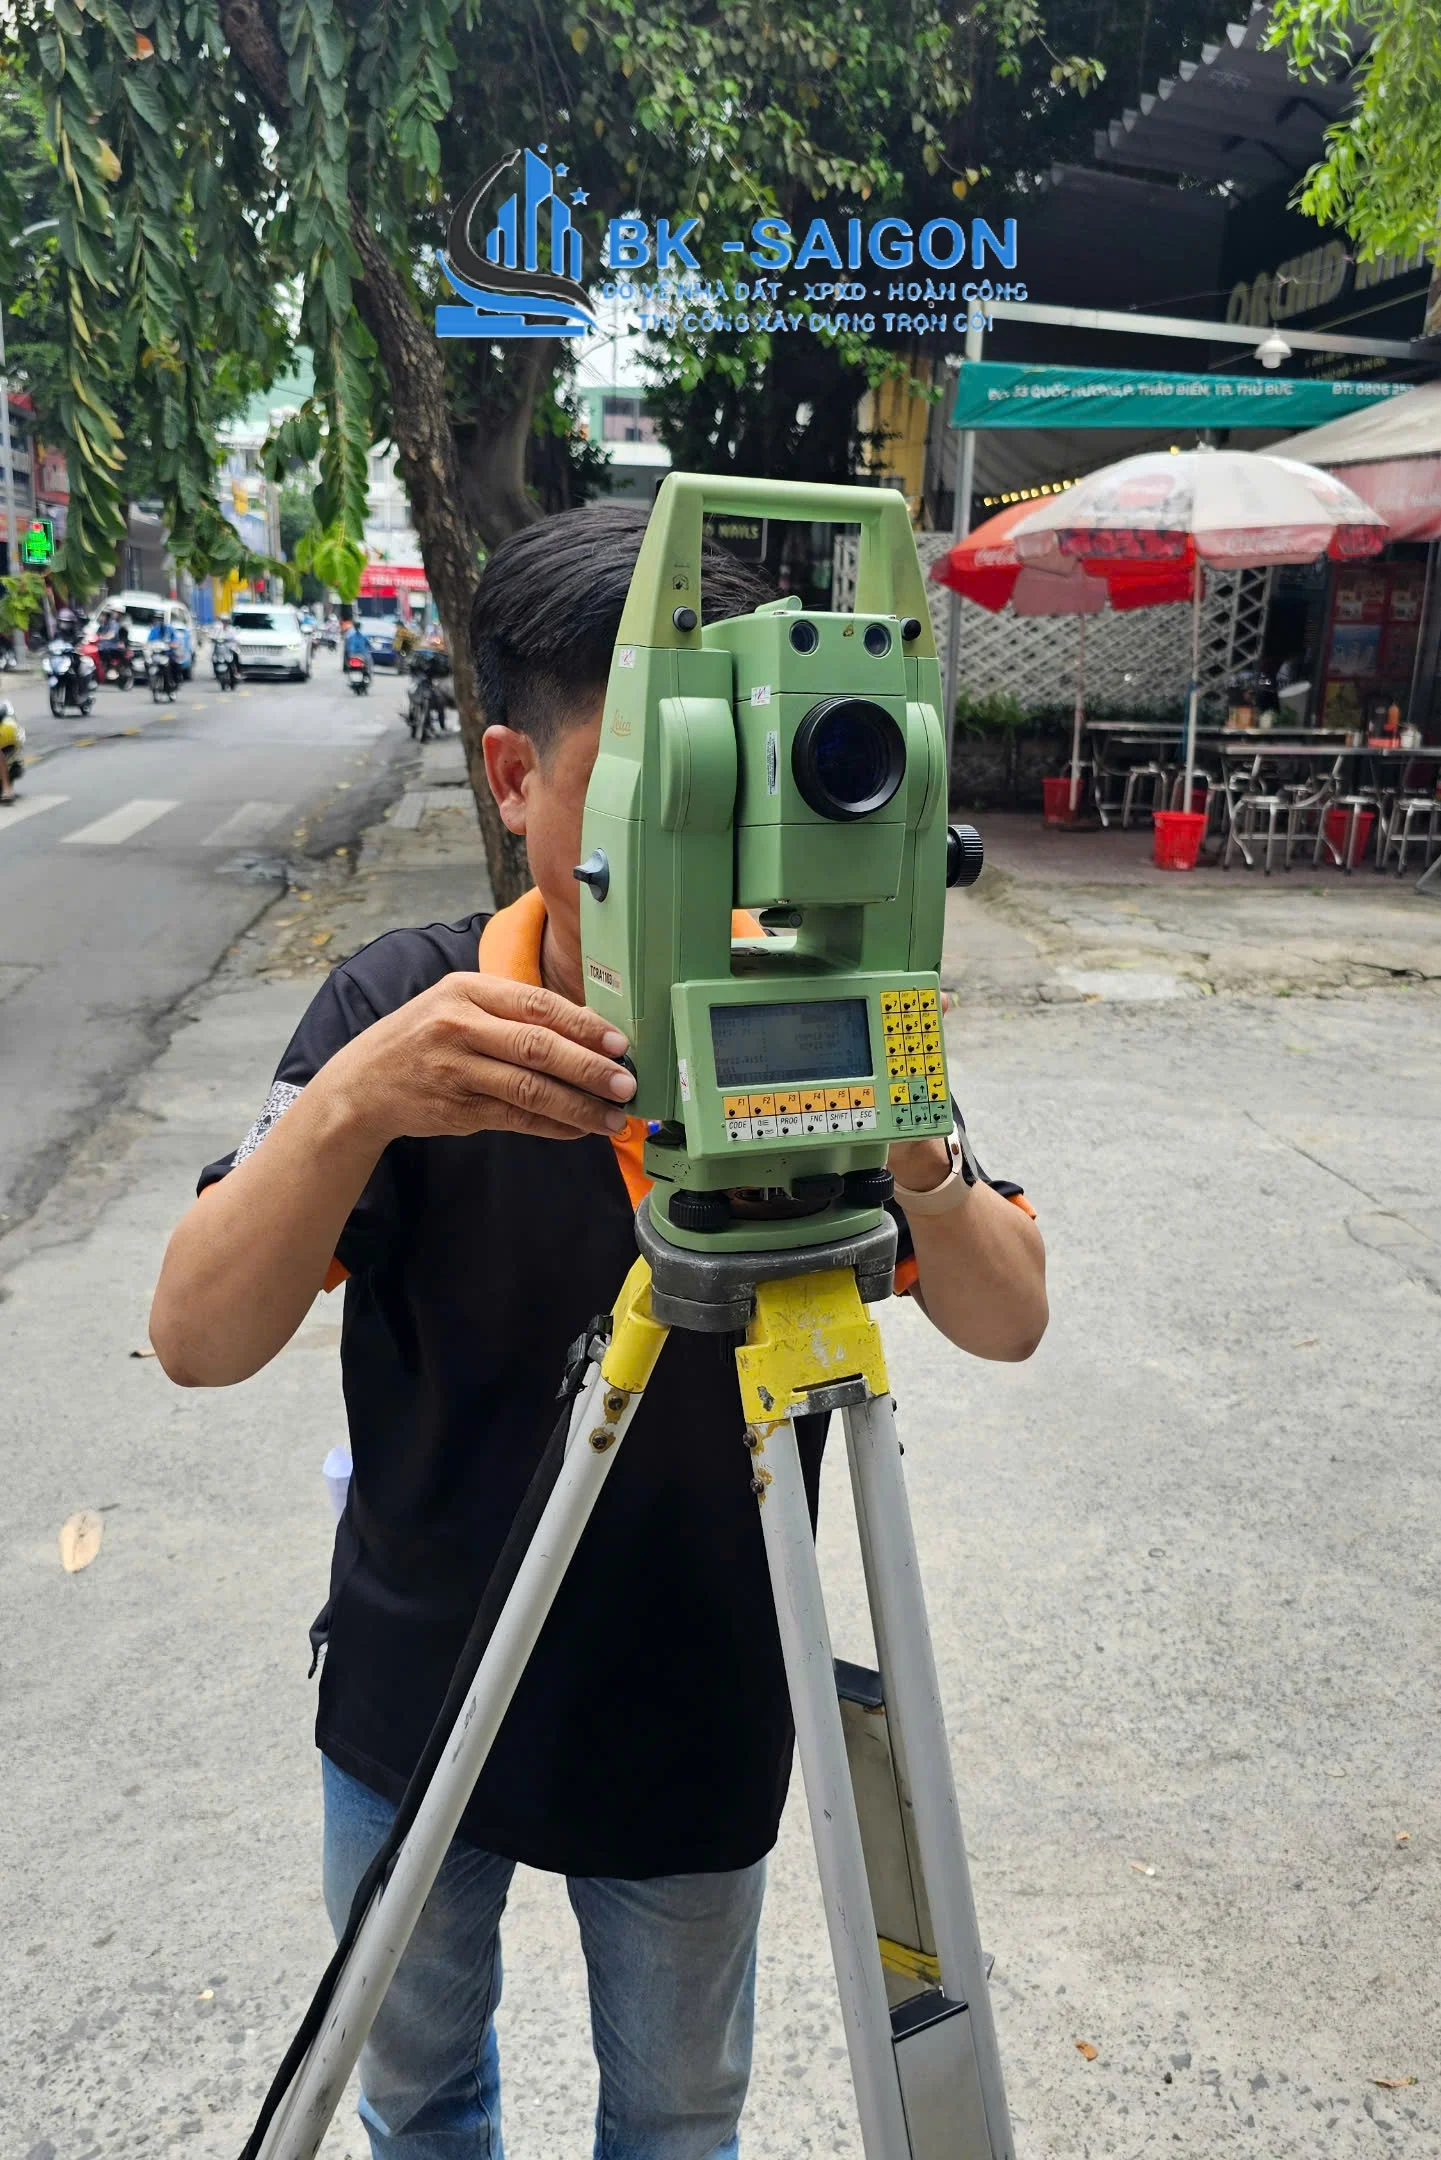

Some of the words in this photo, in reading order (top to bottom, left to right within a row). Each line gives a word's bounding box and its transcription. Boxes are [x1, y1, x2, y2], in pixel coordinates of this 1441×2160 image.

[611, 709, 632, 737] Leica
[788, 1094, 796, 1102] F3
[813, 1092, 821, 1100] F4
[838, 1090, 846, 1098] F5
[862, 1088, 870, 1096] F6
[898, 1086, 906, 1094] CE
[729, 1122, 747, 1130] CODE
[780, 1117, 798, 1125] PROG
[810, 1114, 823, 1122] FNC
[830, 1112, 848, 1120] SHIFT
[860, 1110, 873, 1118] ESC
